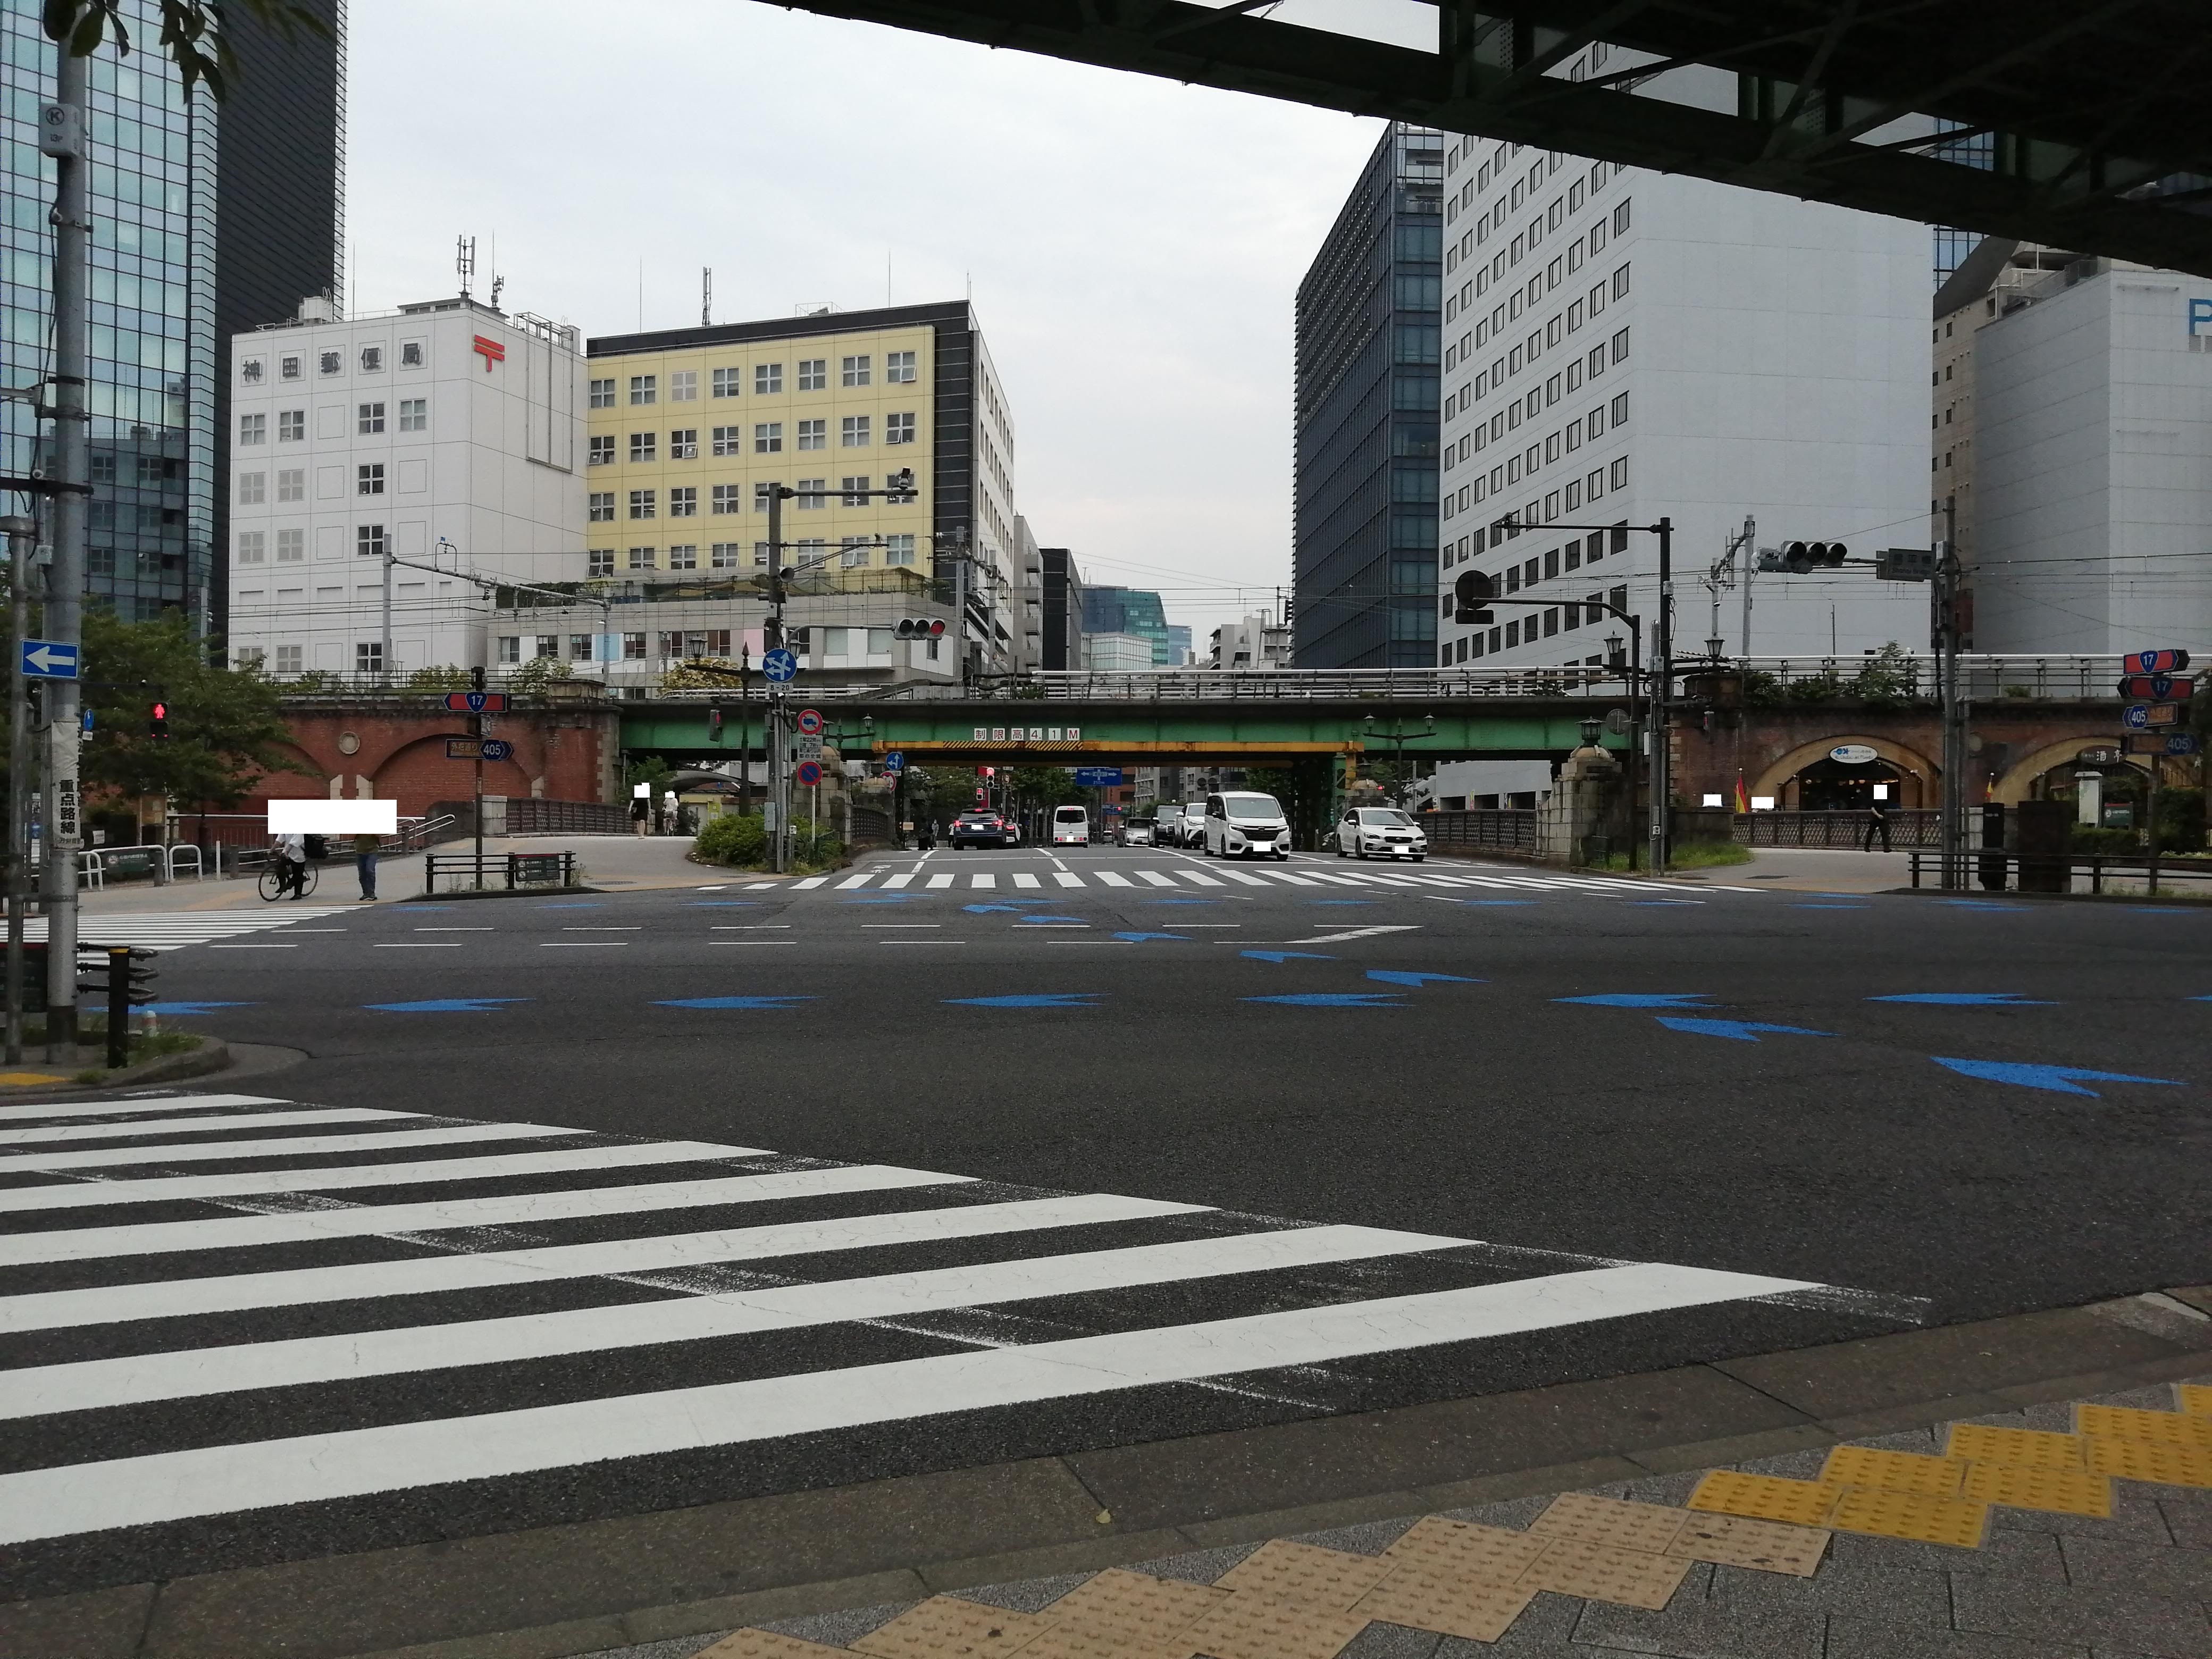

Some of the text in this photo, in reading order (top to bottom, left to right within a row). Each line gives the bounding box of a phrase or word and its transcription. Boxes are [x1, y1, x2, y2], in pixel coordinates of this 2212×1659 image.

[2189, 298, 2212, 335] P
[2143, 654, 2154, 665] 17
[2156, 681, 2168, 692] 17
[471, 695, 483, 705] 17
[2132, 710, 2146, 723] 405
[2167, 738, 2189, 749] 405
[483, 744, 500, 755] 405
[60, 779, 76, 834] 重点路線
